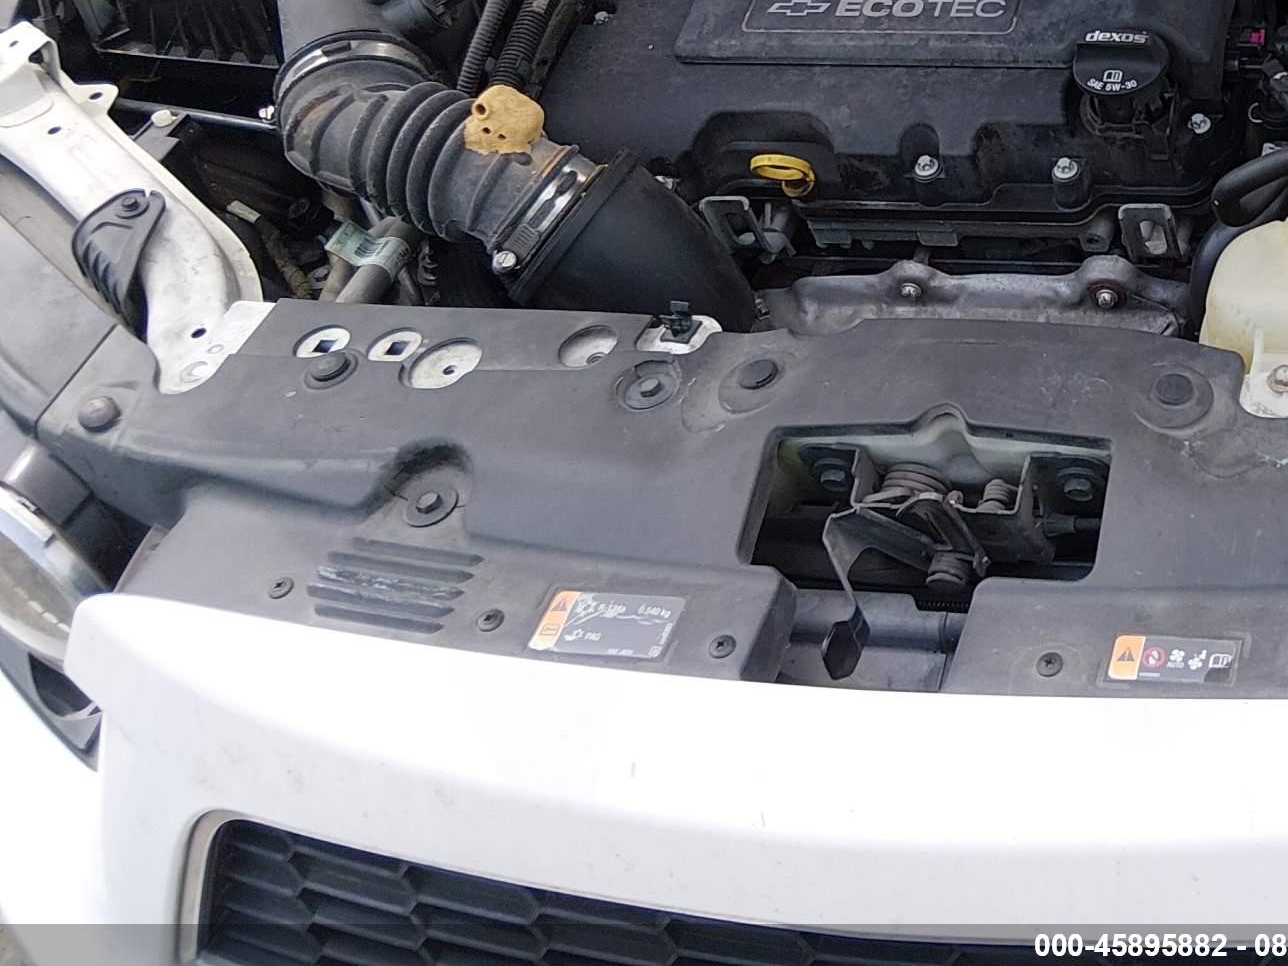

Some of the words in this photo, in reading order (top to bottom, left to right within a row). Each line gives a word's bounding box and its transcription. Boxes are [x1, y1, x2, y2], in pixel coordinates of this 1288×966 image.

[1085, 30, 1149, 44] dexos
[1087, 78, 1104, 90] SAE
[1105, 79, 1138, 91] 5W-30
